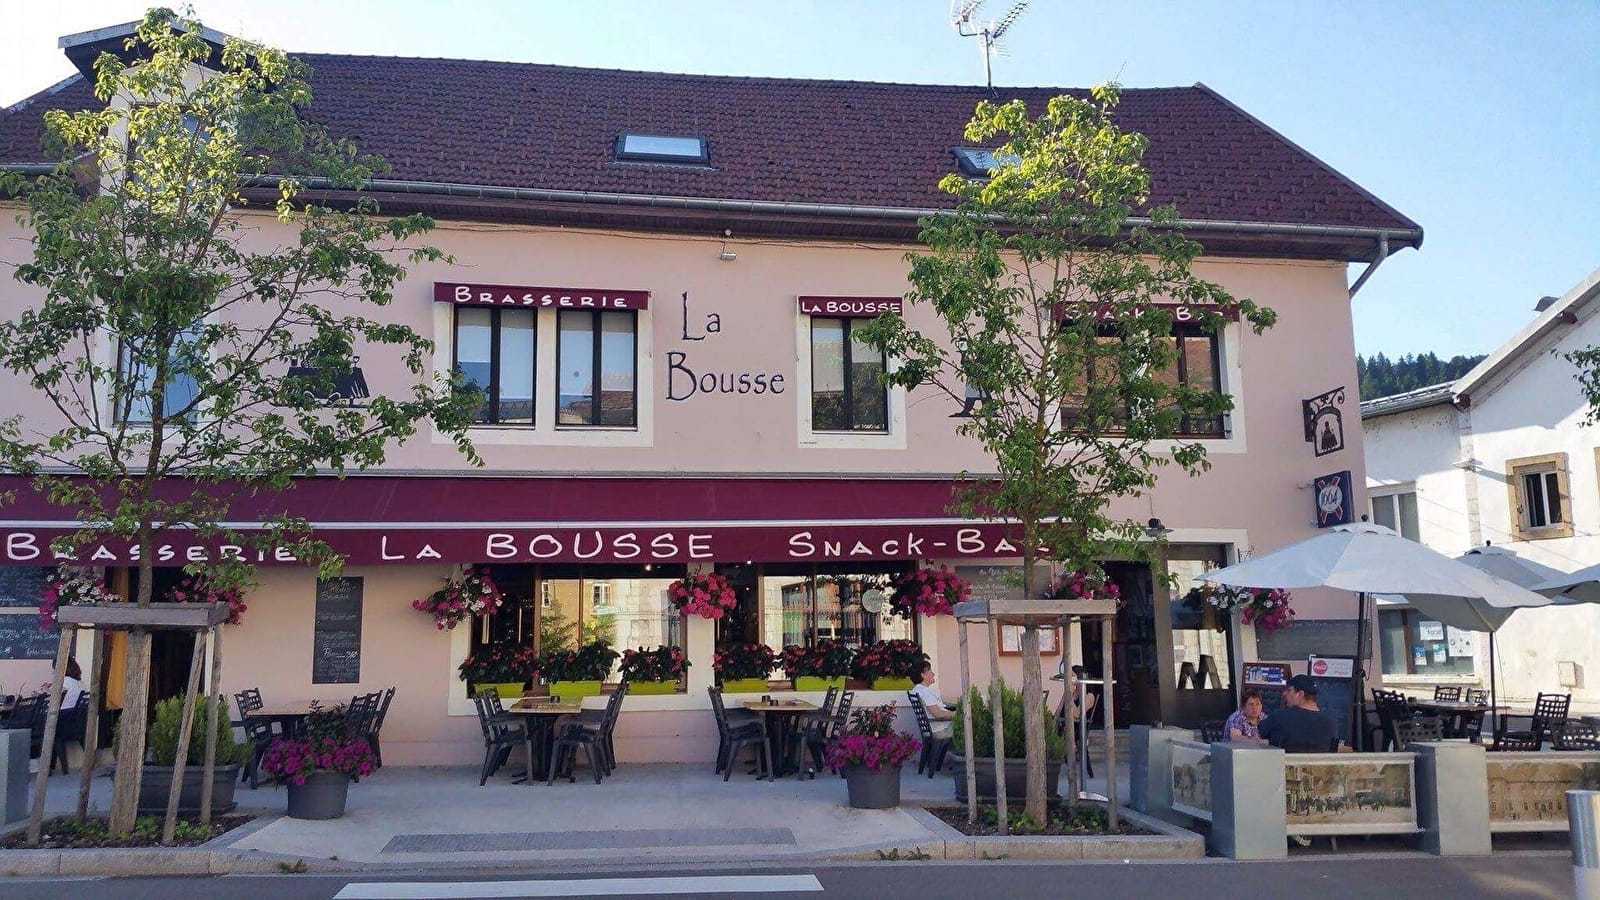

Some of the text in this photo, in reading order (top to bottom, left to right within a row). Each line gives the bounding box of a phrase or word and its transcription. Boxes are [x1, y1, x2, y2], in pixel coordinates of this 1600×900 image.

[454, 285, 628, 308] BRASSERIE
[801, 301, 902, 314] LA BOUSSE
[681, 290, 721, 341] La
[665, 350, 786, 402] Bousse
[380, 534, 442, 561] LA
[485, 531, 714, 559] BOUSSE
